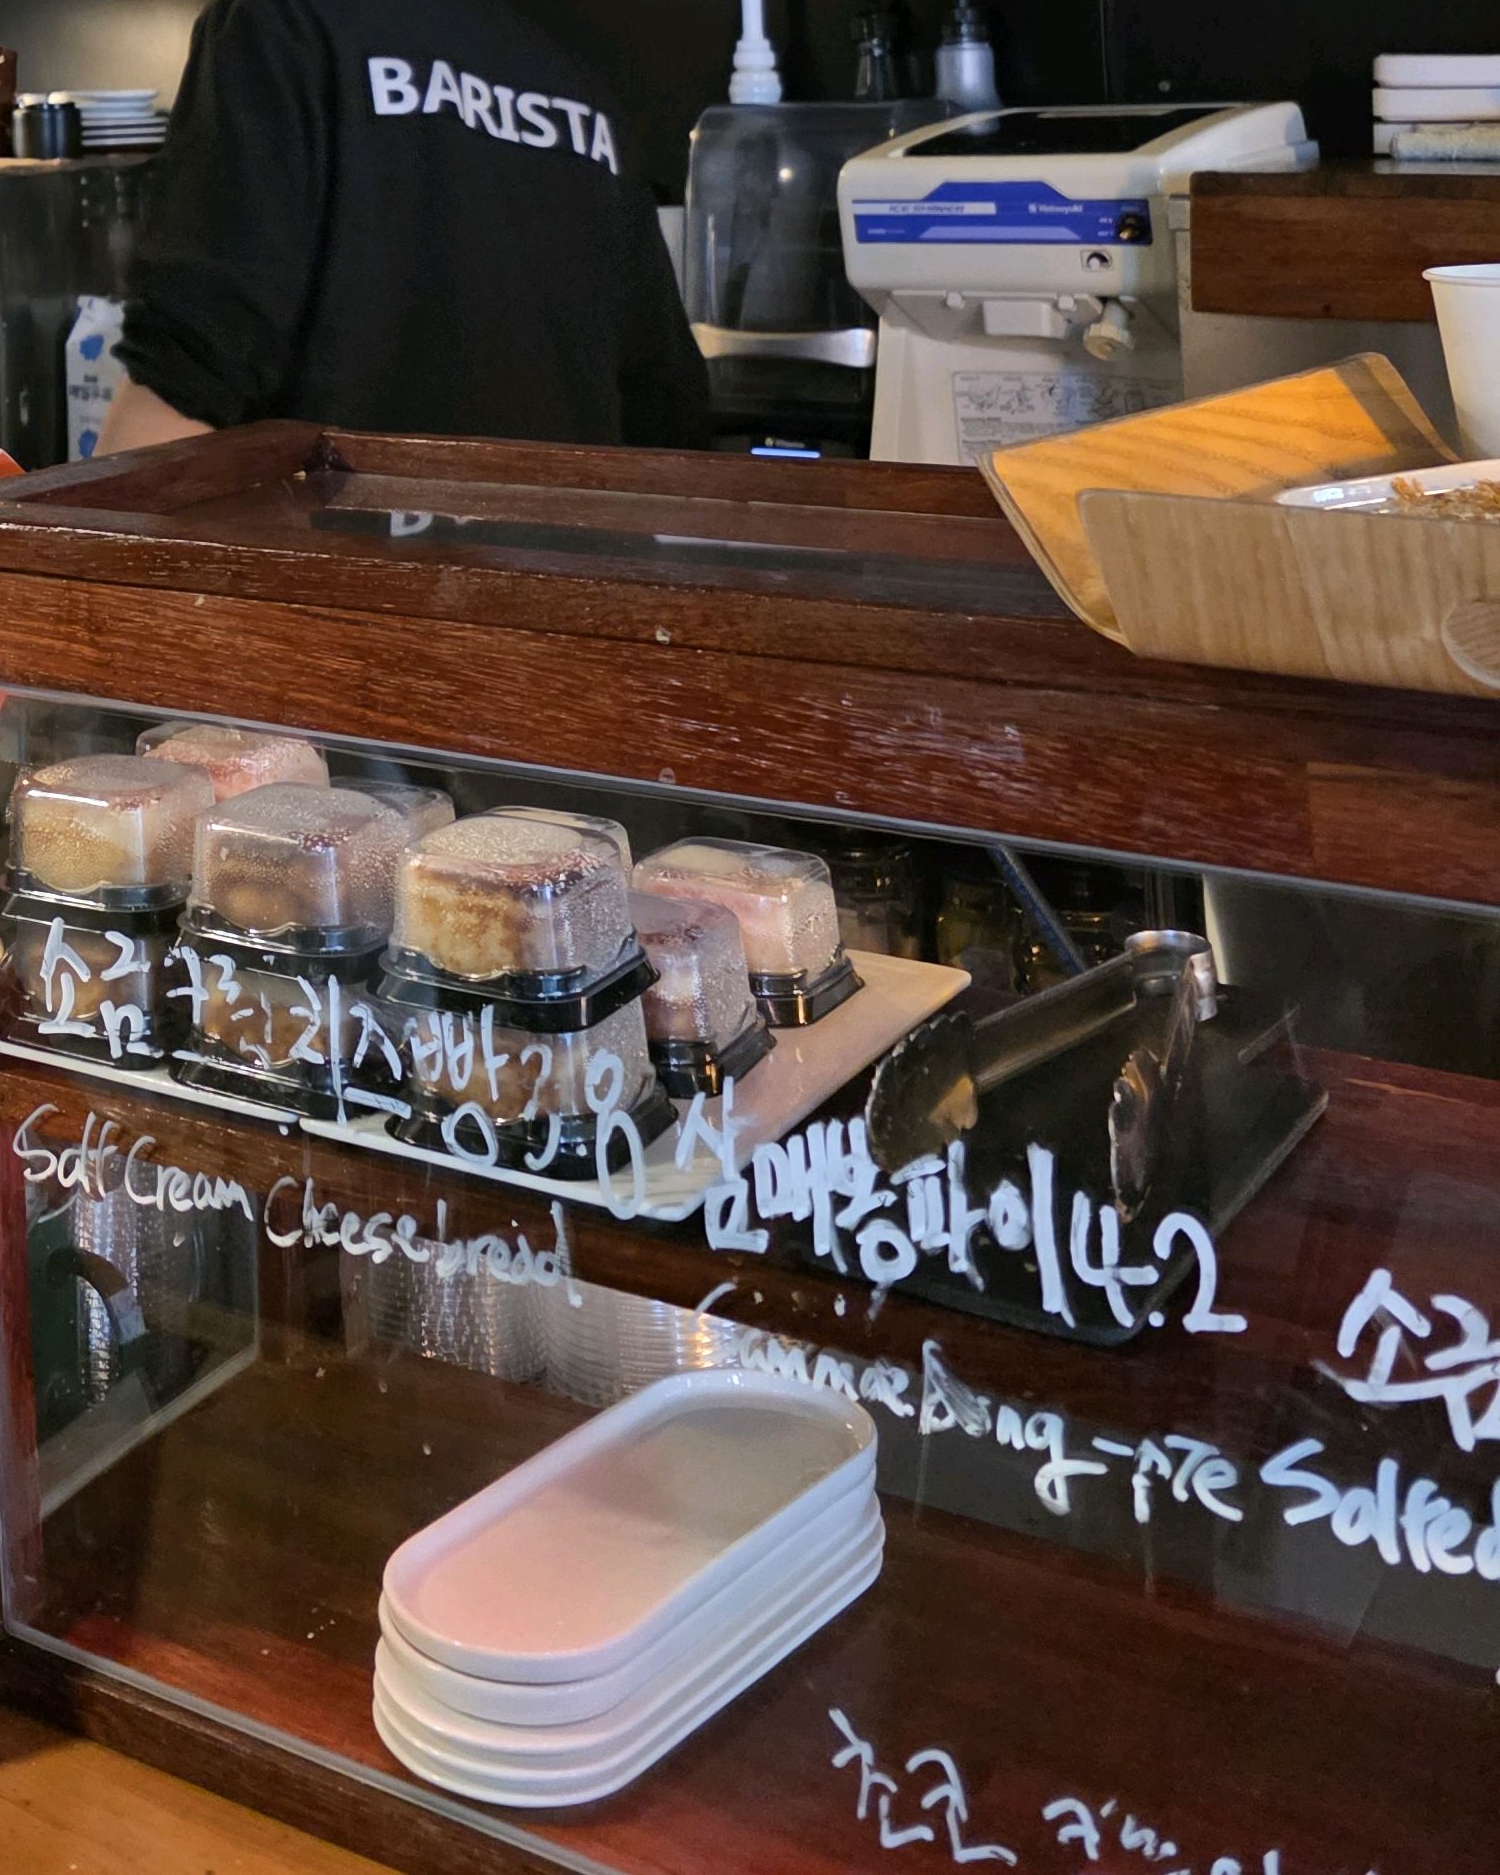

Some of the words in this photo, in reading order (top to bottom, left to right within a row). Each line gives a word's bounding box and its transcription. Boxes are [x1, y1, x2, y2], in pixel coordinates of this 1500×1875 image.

[367, 55, 621, 176] BARISTA
[124, 1135, 255, 1222] Cream
[827, 1707, 1018, 1866] 초코
